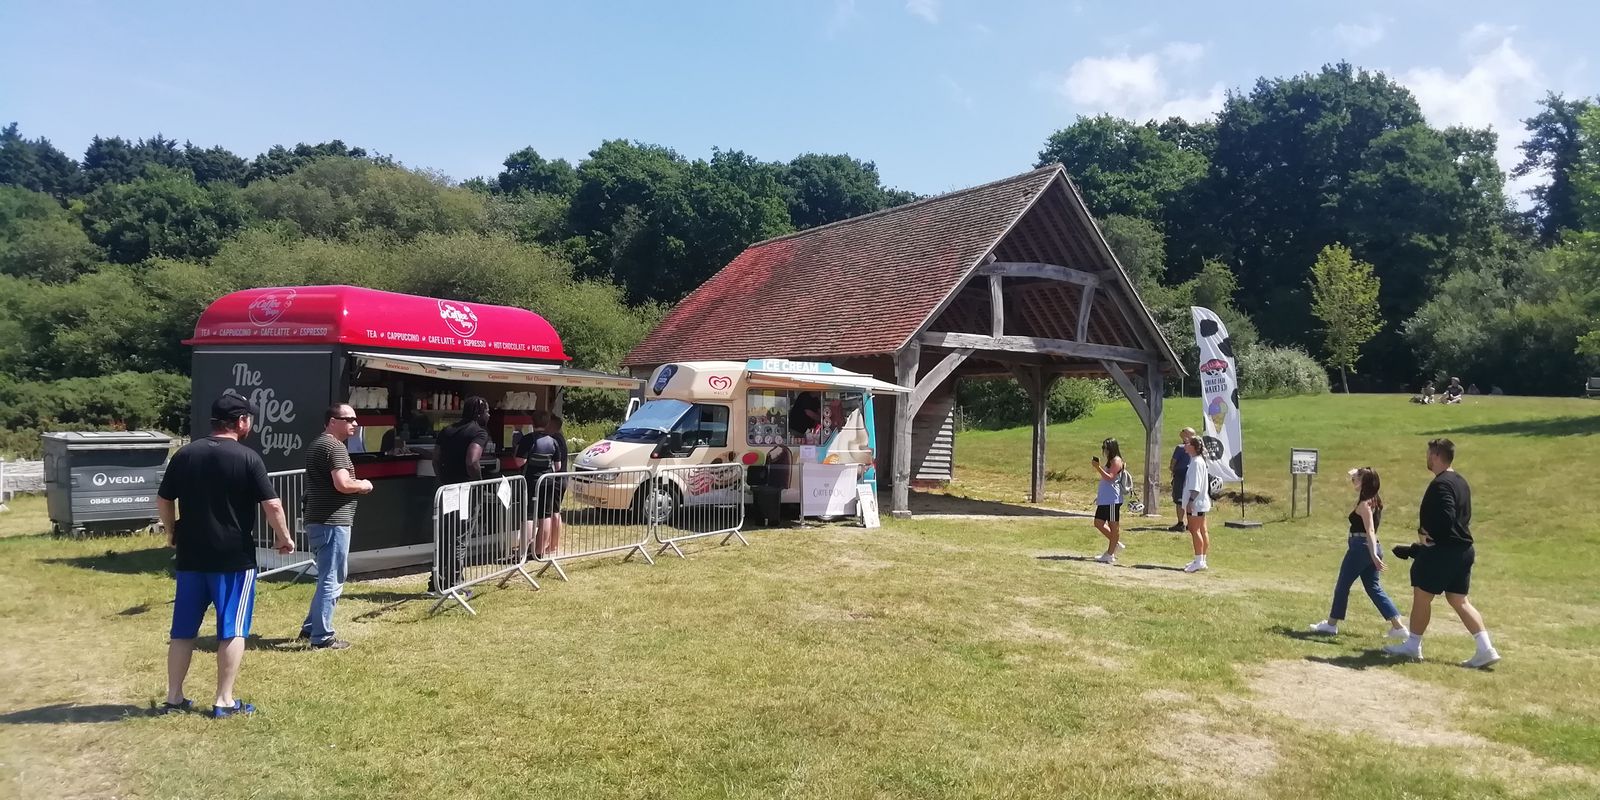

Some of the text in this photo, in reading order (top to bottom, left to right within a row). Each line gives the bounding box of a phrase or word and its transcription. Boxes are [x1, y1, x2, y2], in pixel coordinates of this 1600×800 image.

[219, 328, 251, 336] CAPPUCCINO
[260, 328, 274, 336] CAFE
[274, 328, 290, 336] LATTE
[300, 328, 327, 336] ESPRESSO
[366, 330, 378, 339] TEA
[387, 332, 420, 342] CAPPUCCINO
[428, 336, 441, 344] CAFE
[441, 337, 455, 345] LATTE
[463, 339, 486, 348] ESPRESSO
[502, 343, 526, 351] CHOCOLATE
[531, 345, 550, 353] PASTRIES
[385, 362, 410, 371] Americano
[762, 360, 819, 373] ICE CREAM
[232, 363, 262, 386] The
[261, 426, 302, 456] Guys
[108, 476, 145, 484] VEOLIA
